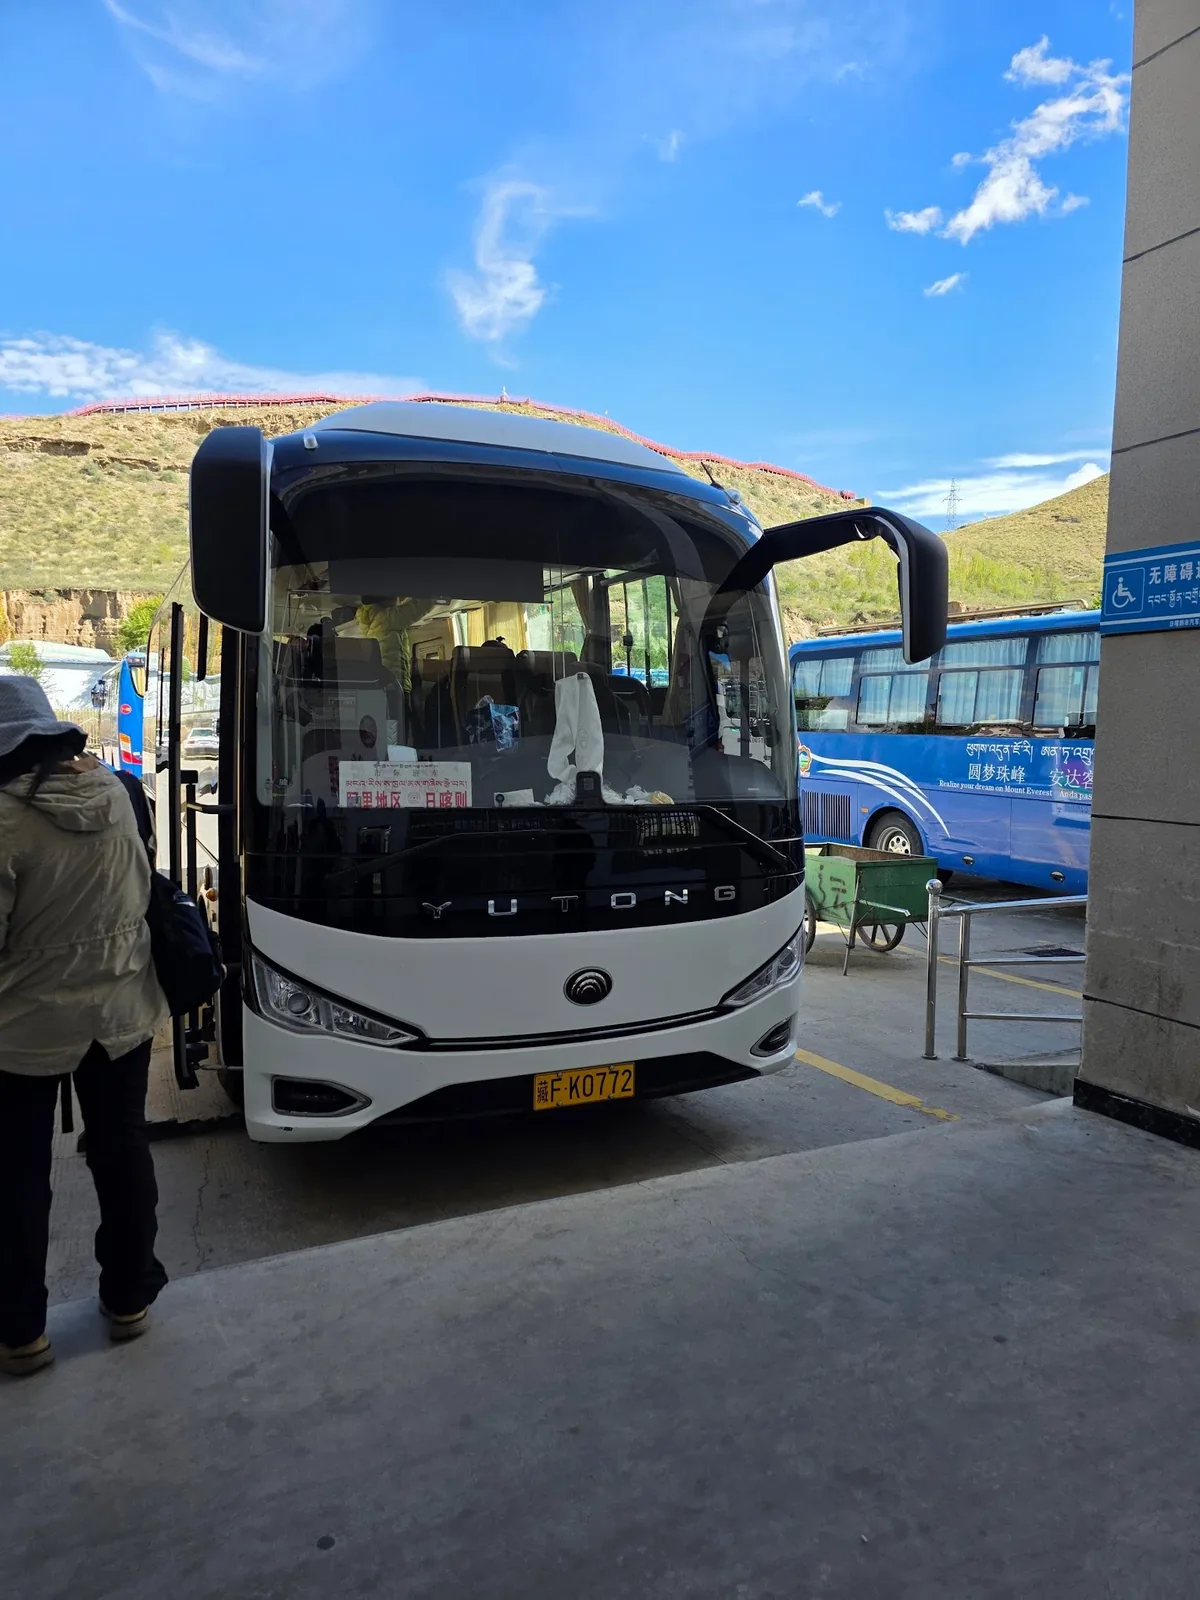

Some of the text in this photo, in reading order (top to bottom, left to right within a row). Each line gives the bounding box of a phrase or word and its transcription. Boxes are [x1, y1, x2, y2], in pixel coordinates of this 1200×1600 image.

[968, 763, 1094, 789] 圆梦珠峰 安达客
[426, 790, 467, 808] 日喀则
[939, 779, 960, 788] Realize
[974, 782, 995, 792] dream
[1004, 785, 1026, 795] Mount
[1026, 787, 1052, 797] Everest
[422, 885, 736, 919] YUTONG
